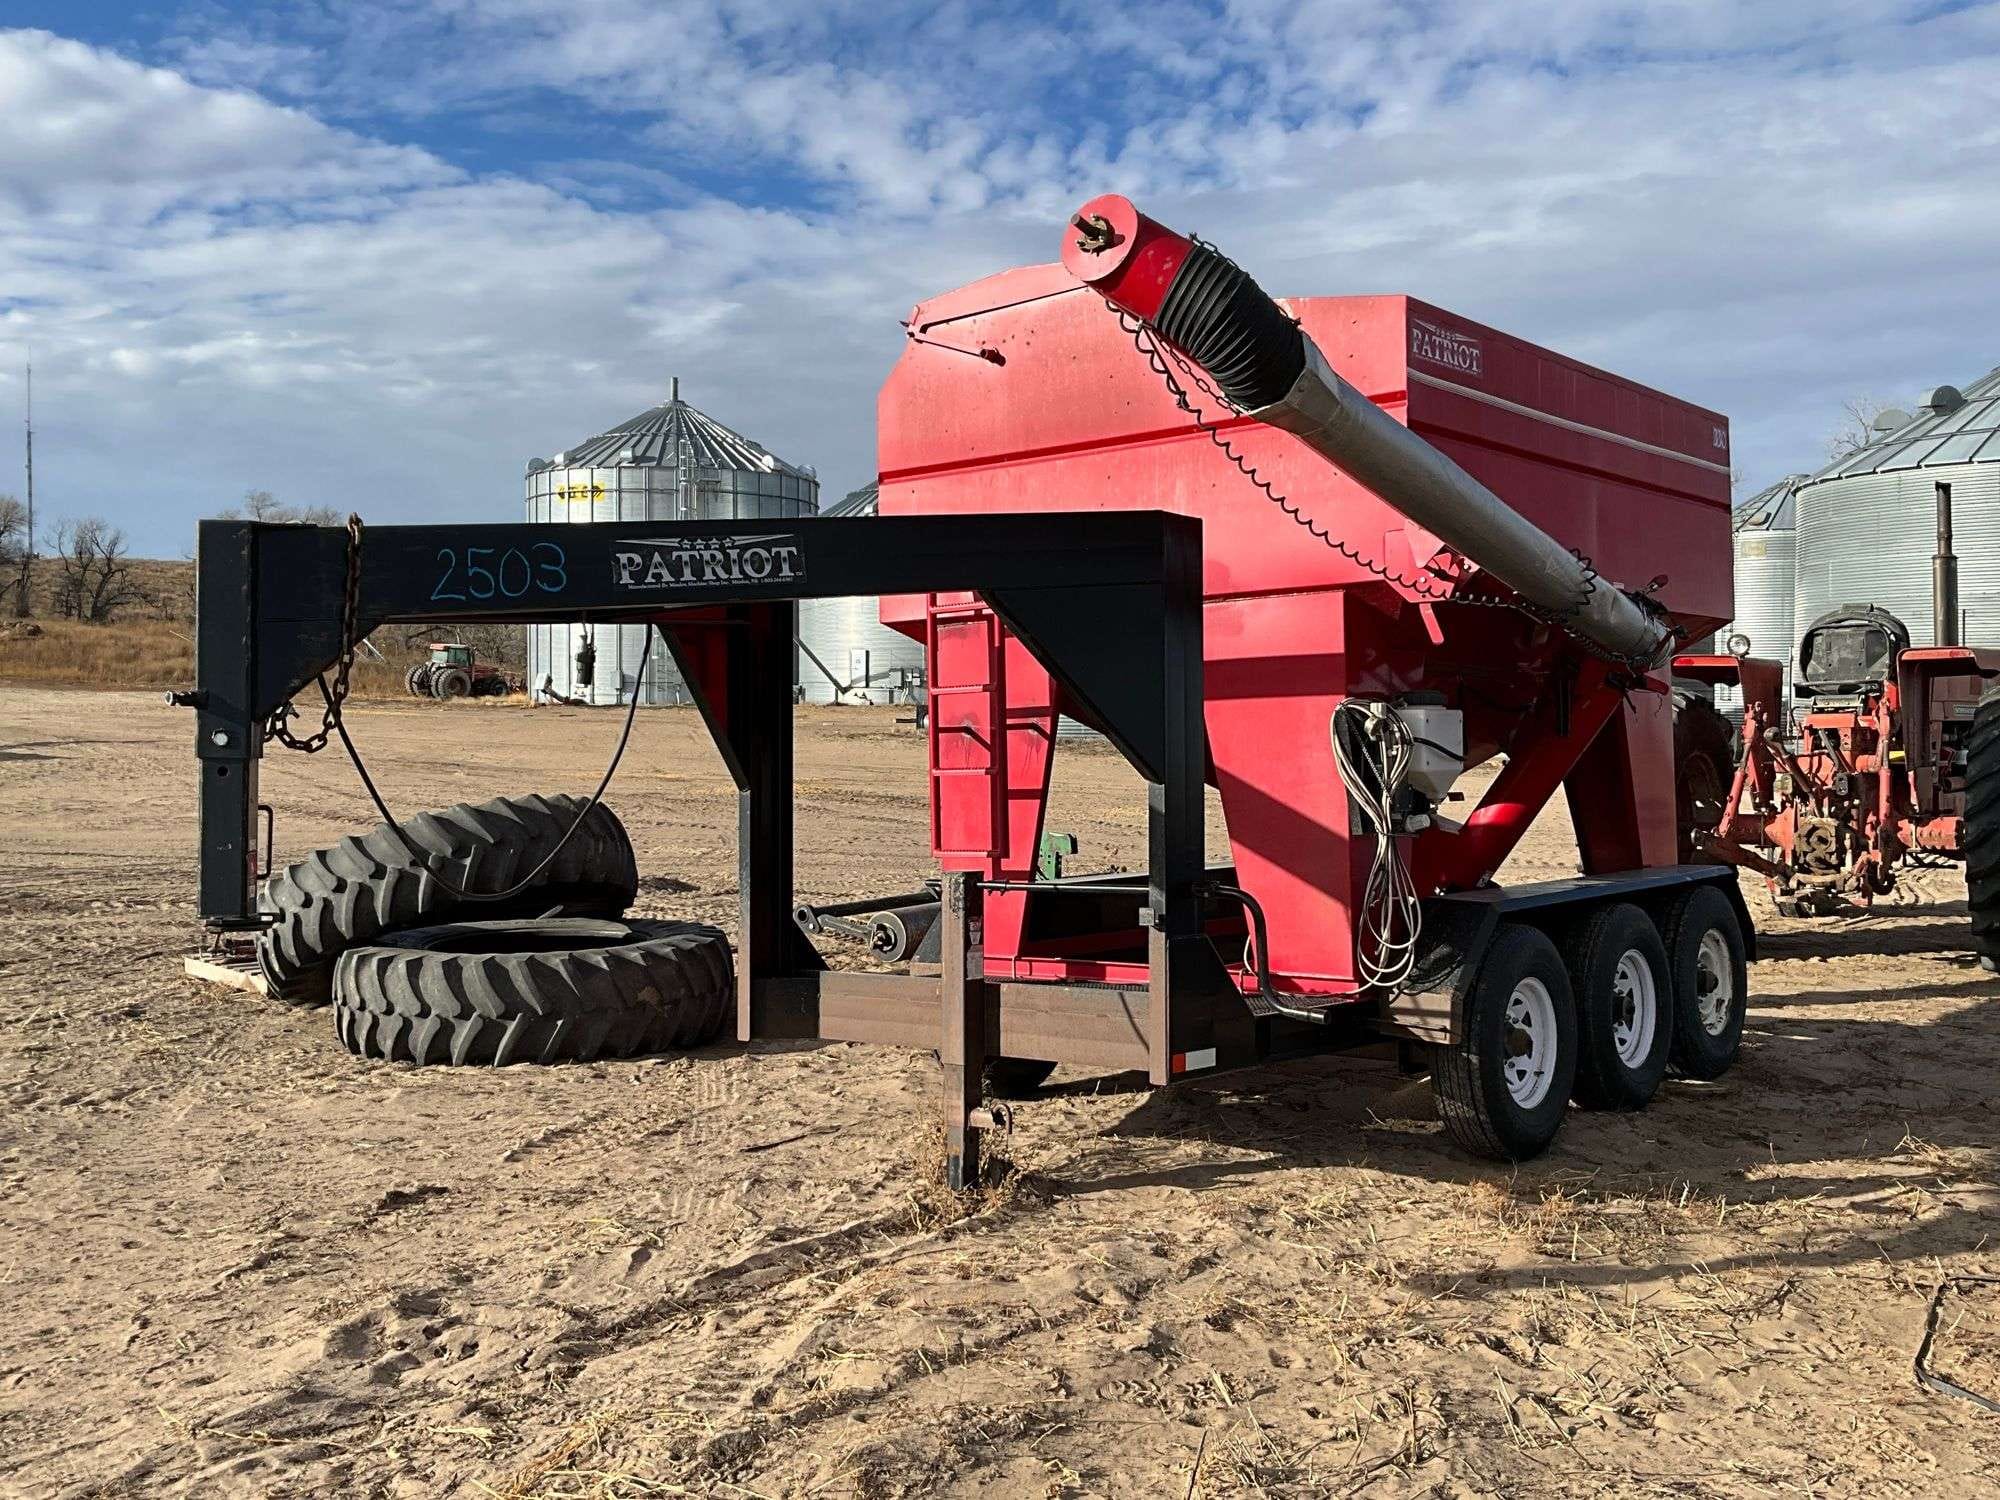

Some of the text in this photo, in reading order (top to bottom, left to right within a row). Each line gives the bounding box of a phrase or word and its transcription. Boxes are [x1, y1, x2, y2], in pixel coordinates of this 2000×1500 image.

[1412, 328, 1480, 372] PATRIOT
[430, 542, 567, 600] 2503
[615, 546, 798, 584] PATRIOT
